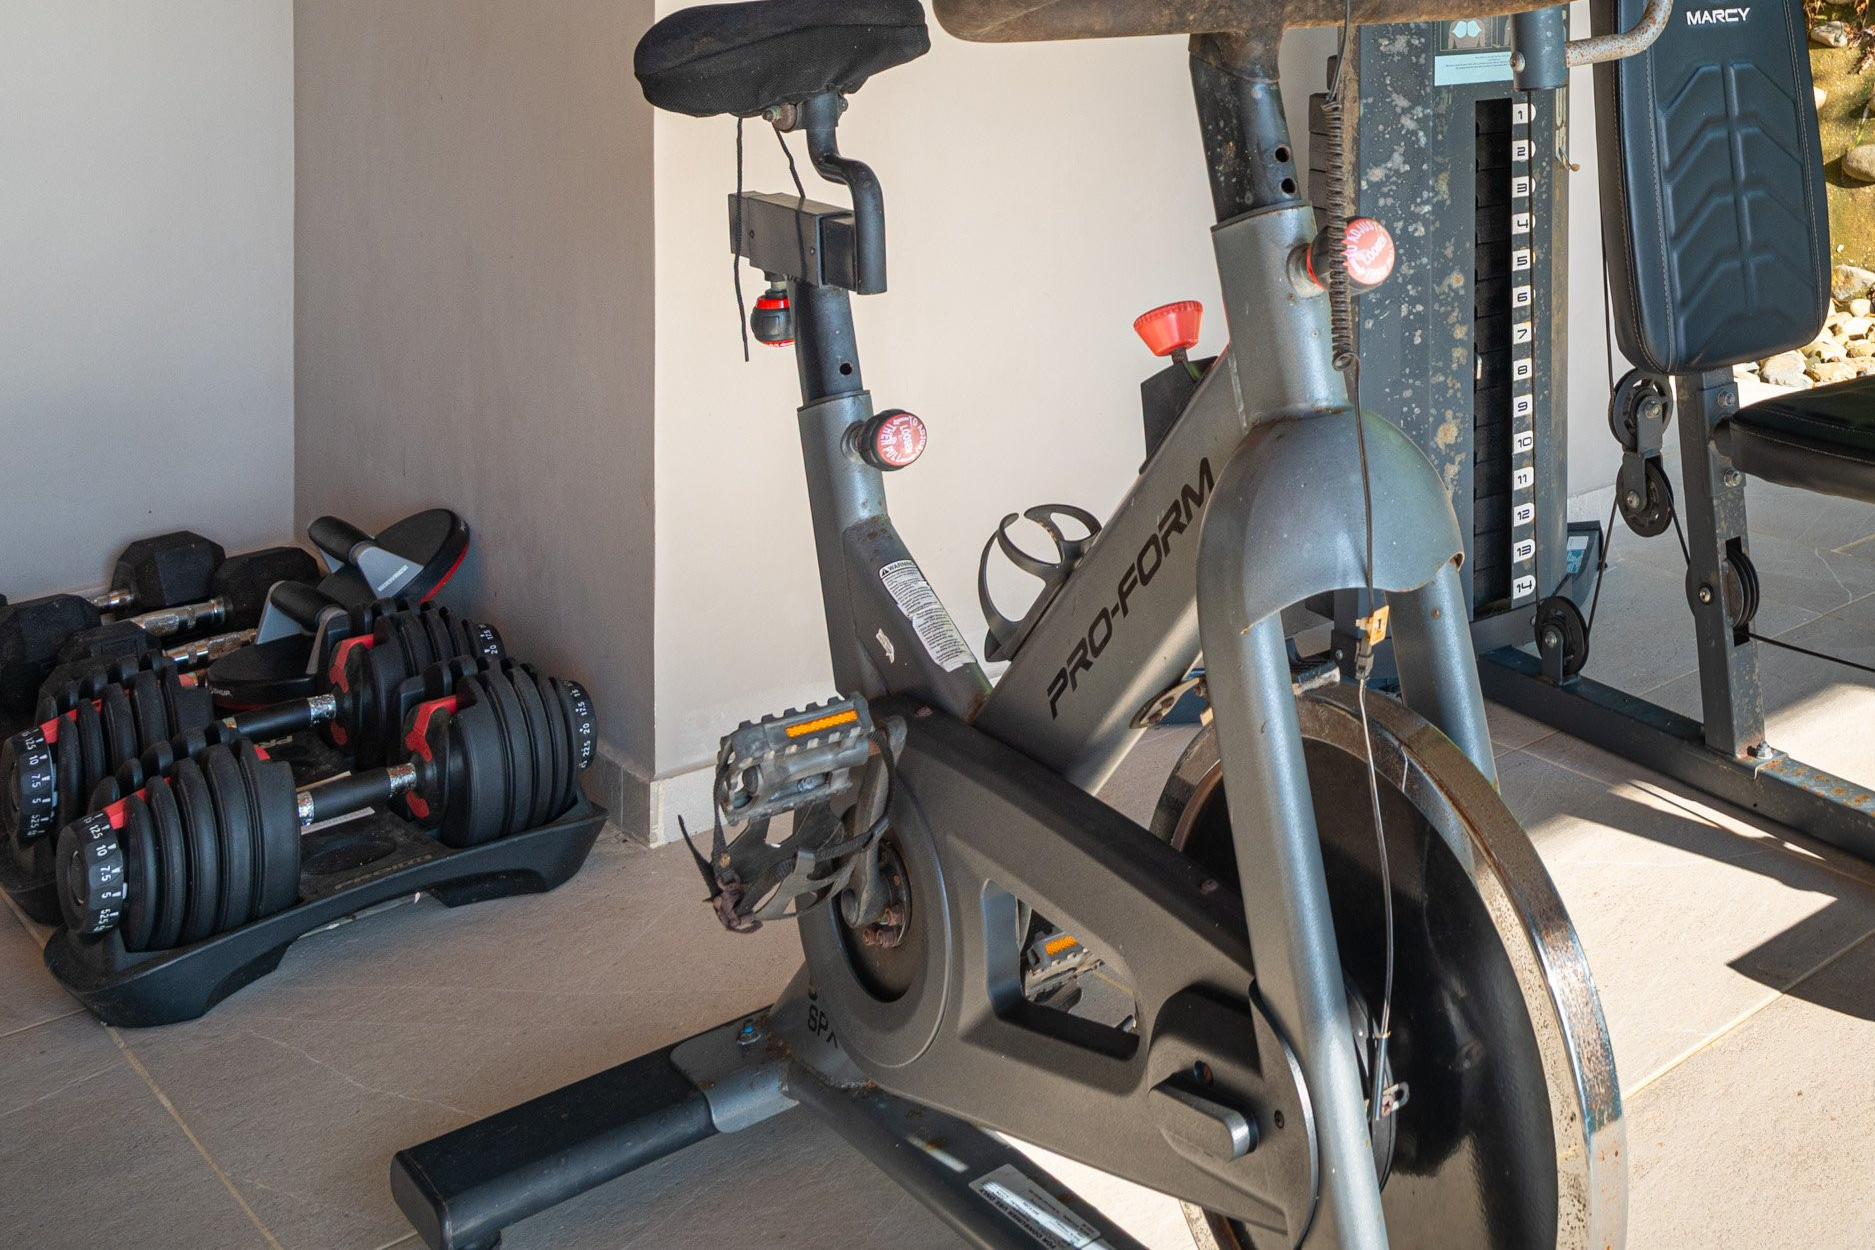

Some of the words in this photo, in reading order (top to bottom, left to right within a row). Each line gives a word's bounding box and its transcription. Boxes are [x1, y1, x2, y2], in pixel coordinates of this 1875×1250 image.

[1686, 7, 1750, 25] MARCY
[1516, 110, 1523, 120] 1
[1516, 146, 1526, 157] 2
[1516, 182, 1528, 193] 3
[1516, 218, 1529, 229] 4
[1516, 255, 1528, 266] 5
[1516, 292, 1528, 303] 6
[1516, 329, 1528, 341] 7
[1517, 365, 1528, 376] 8
[1517, 401, 1528, 412] 9
[880, 423, 897, 446] THEN
[1517, 436, 1533, 449] 10
[1517, 474, 1527, 484] 11
[1516, 509, 1530, 521] 12
[1516, 544, 1532, 557] 13
[1046, 456, 1215, 721] PRO-FORM
[1516, 580, 1533, 593] 14
[582, 722, 591, 735] 20
[29, 754, 39, 765] 10
[31, 773, 41, 788] 7.5
[96, 844, 108, 856] 10
[100, 865, 112, 882] 7.5
[101, 891, 112, 899] 5
